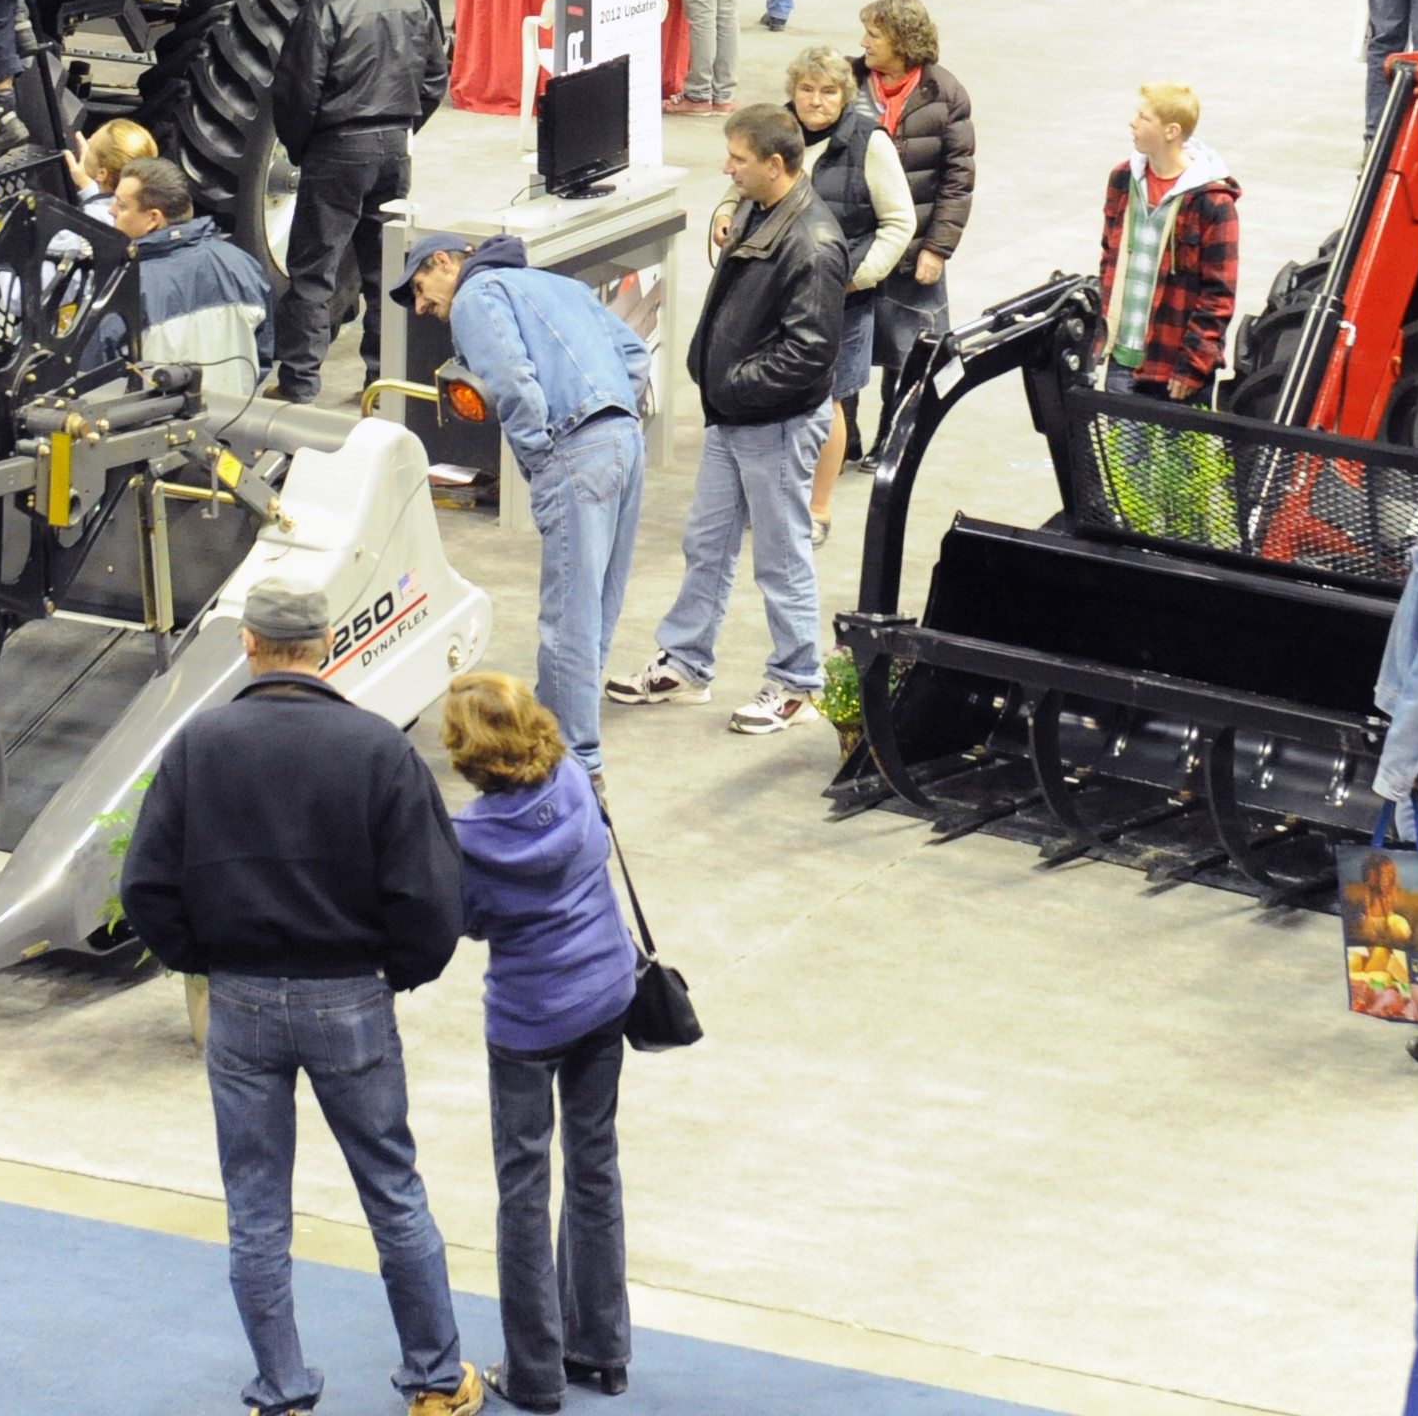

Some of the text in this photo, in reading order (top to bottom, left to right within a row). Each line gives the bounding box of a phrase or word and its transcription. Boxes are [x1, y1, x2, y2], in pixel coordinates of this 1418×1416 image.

[600, 0, 657, 25] 2012 Updates
[318, 591, 394, 672] 250
